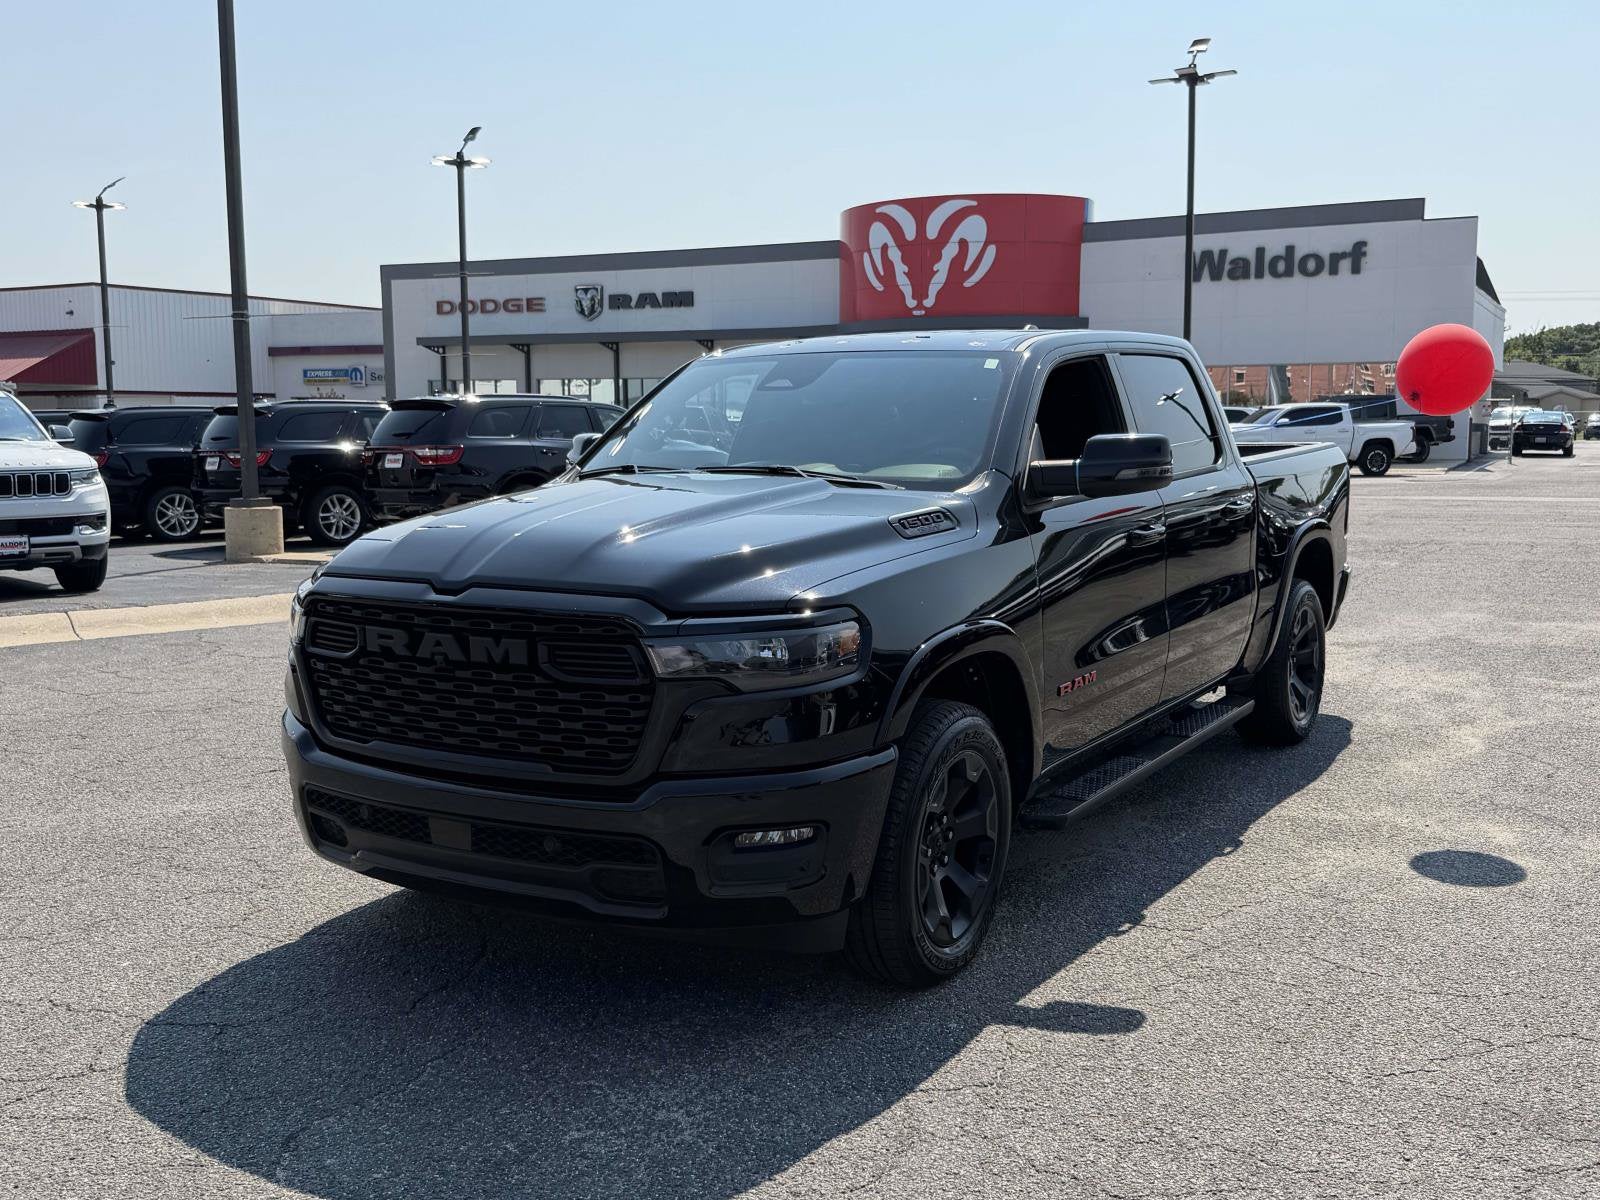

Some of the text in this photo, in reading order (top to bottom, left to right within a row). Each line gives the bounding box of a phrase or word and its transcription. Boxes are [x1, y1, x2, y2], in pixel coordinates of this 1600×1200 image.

[1192, 241, 1367, 282] Waldorf
[436, 297, 546, 315] DODGE
[608, 291, 694, 310] RAM
[900, 513, 945, 529] 1500
[365, 624, 529, 666] RAM
[1057, 670, 1097, 697] RAM
